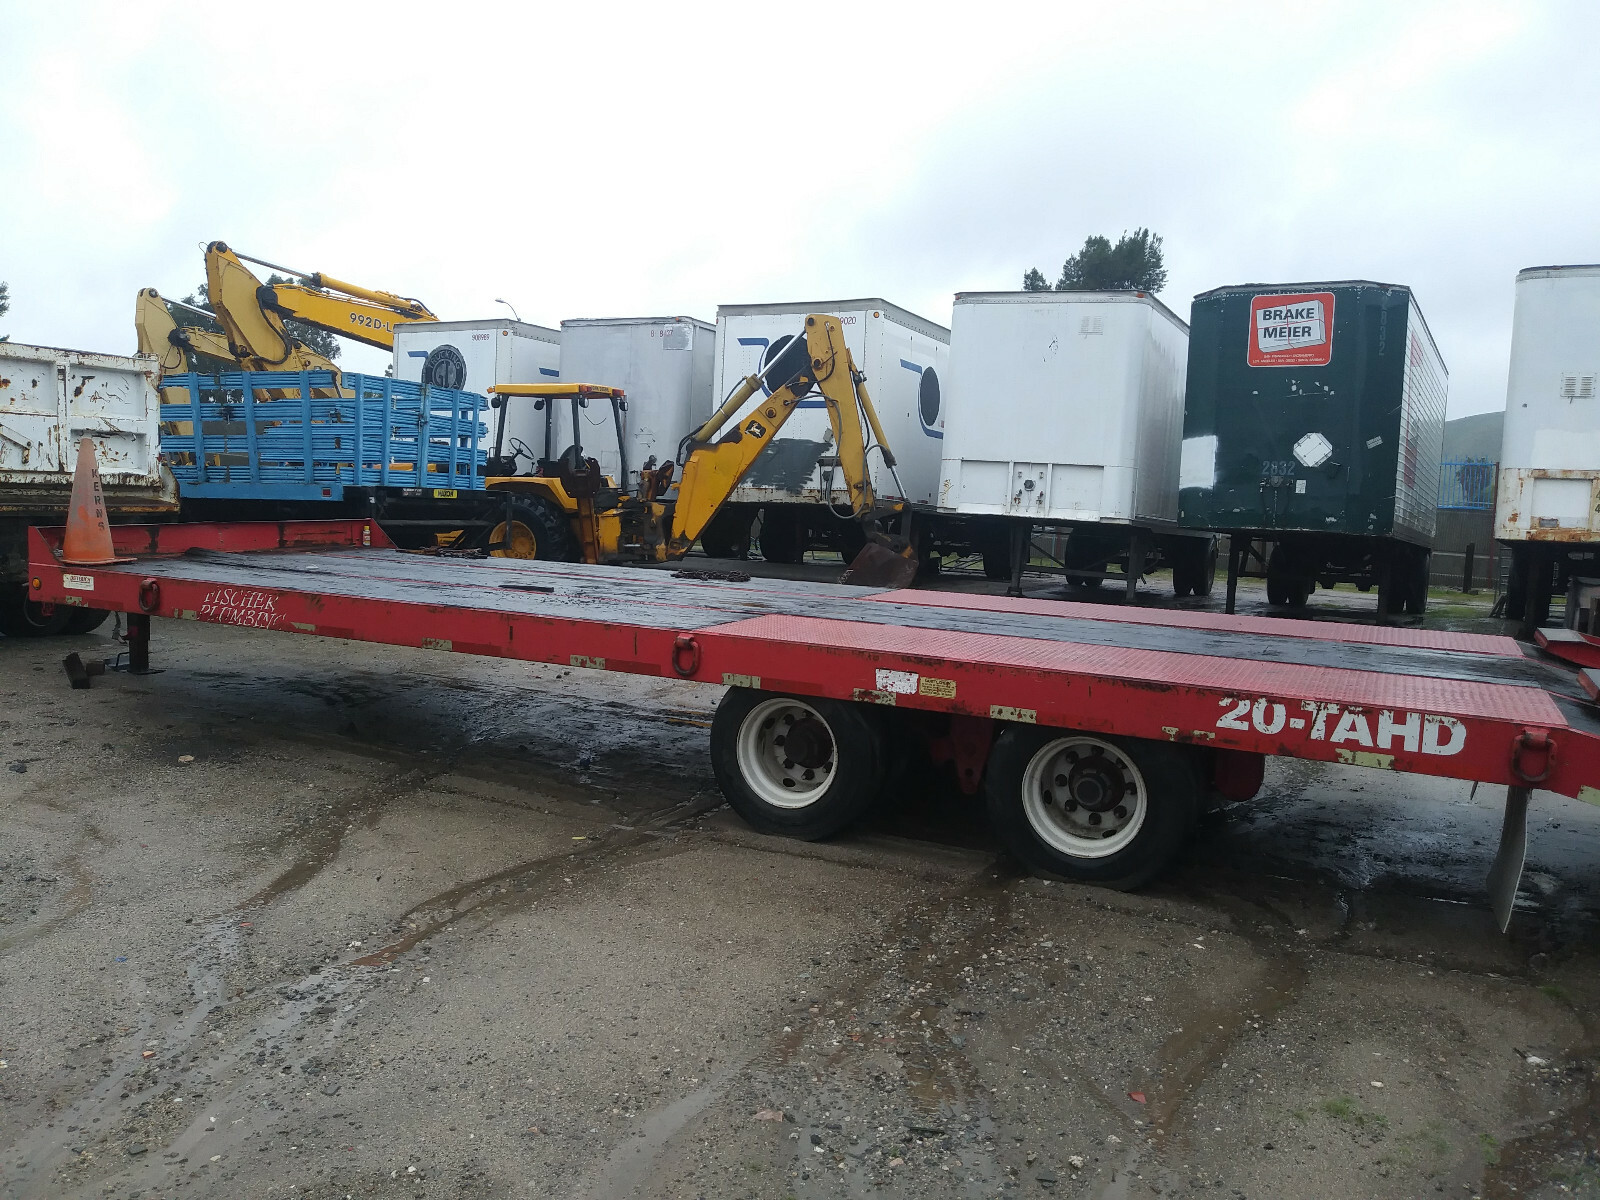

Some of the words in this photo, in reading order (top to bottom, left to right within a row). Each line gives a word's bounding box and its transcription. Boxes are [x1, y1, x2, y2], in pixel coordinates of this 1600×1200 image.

[1262, 307, 1315, 321] BRAKE
[1263, 325, 1312, 339] MEIER
[427, 350, 462, 370] TRUCKING
[91, 468, 105, 532] KERNS
[1215, 697, 1467, 756] 20-TAHD
